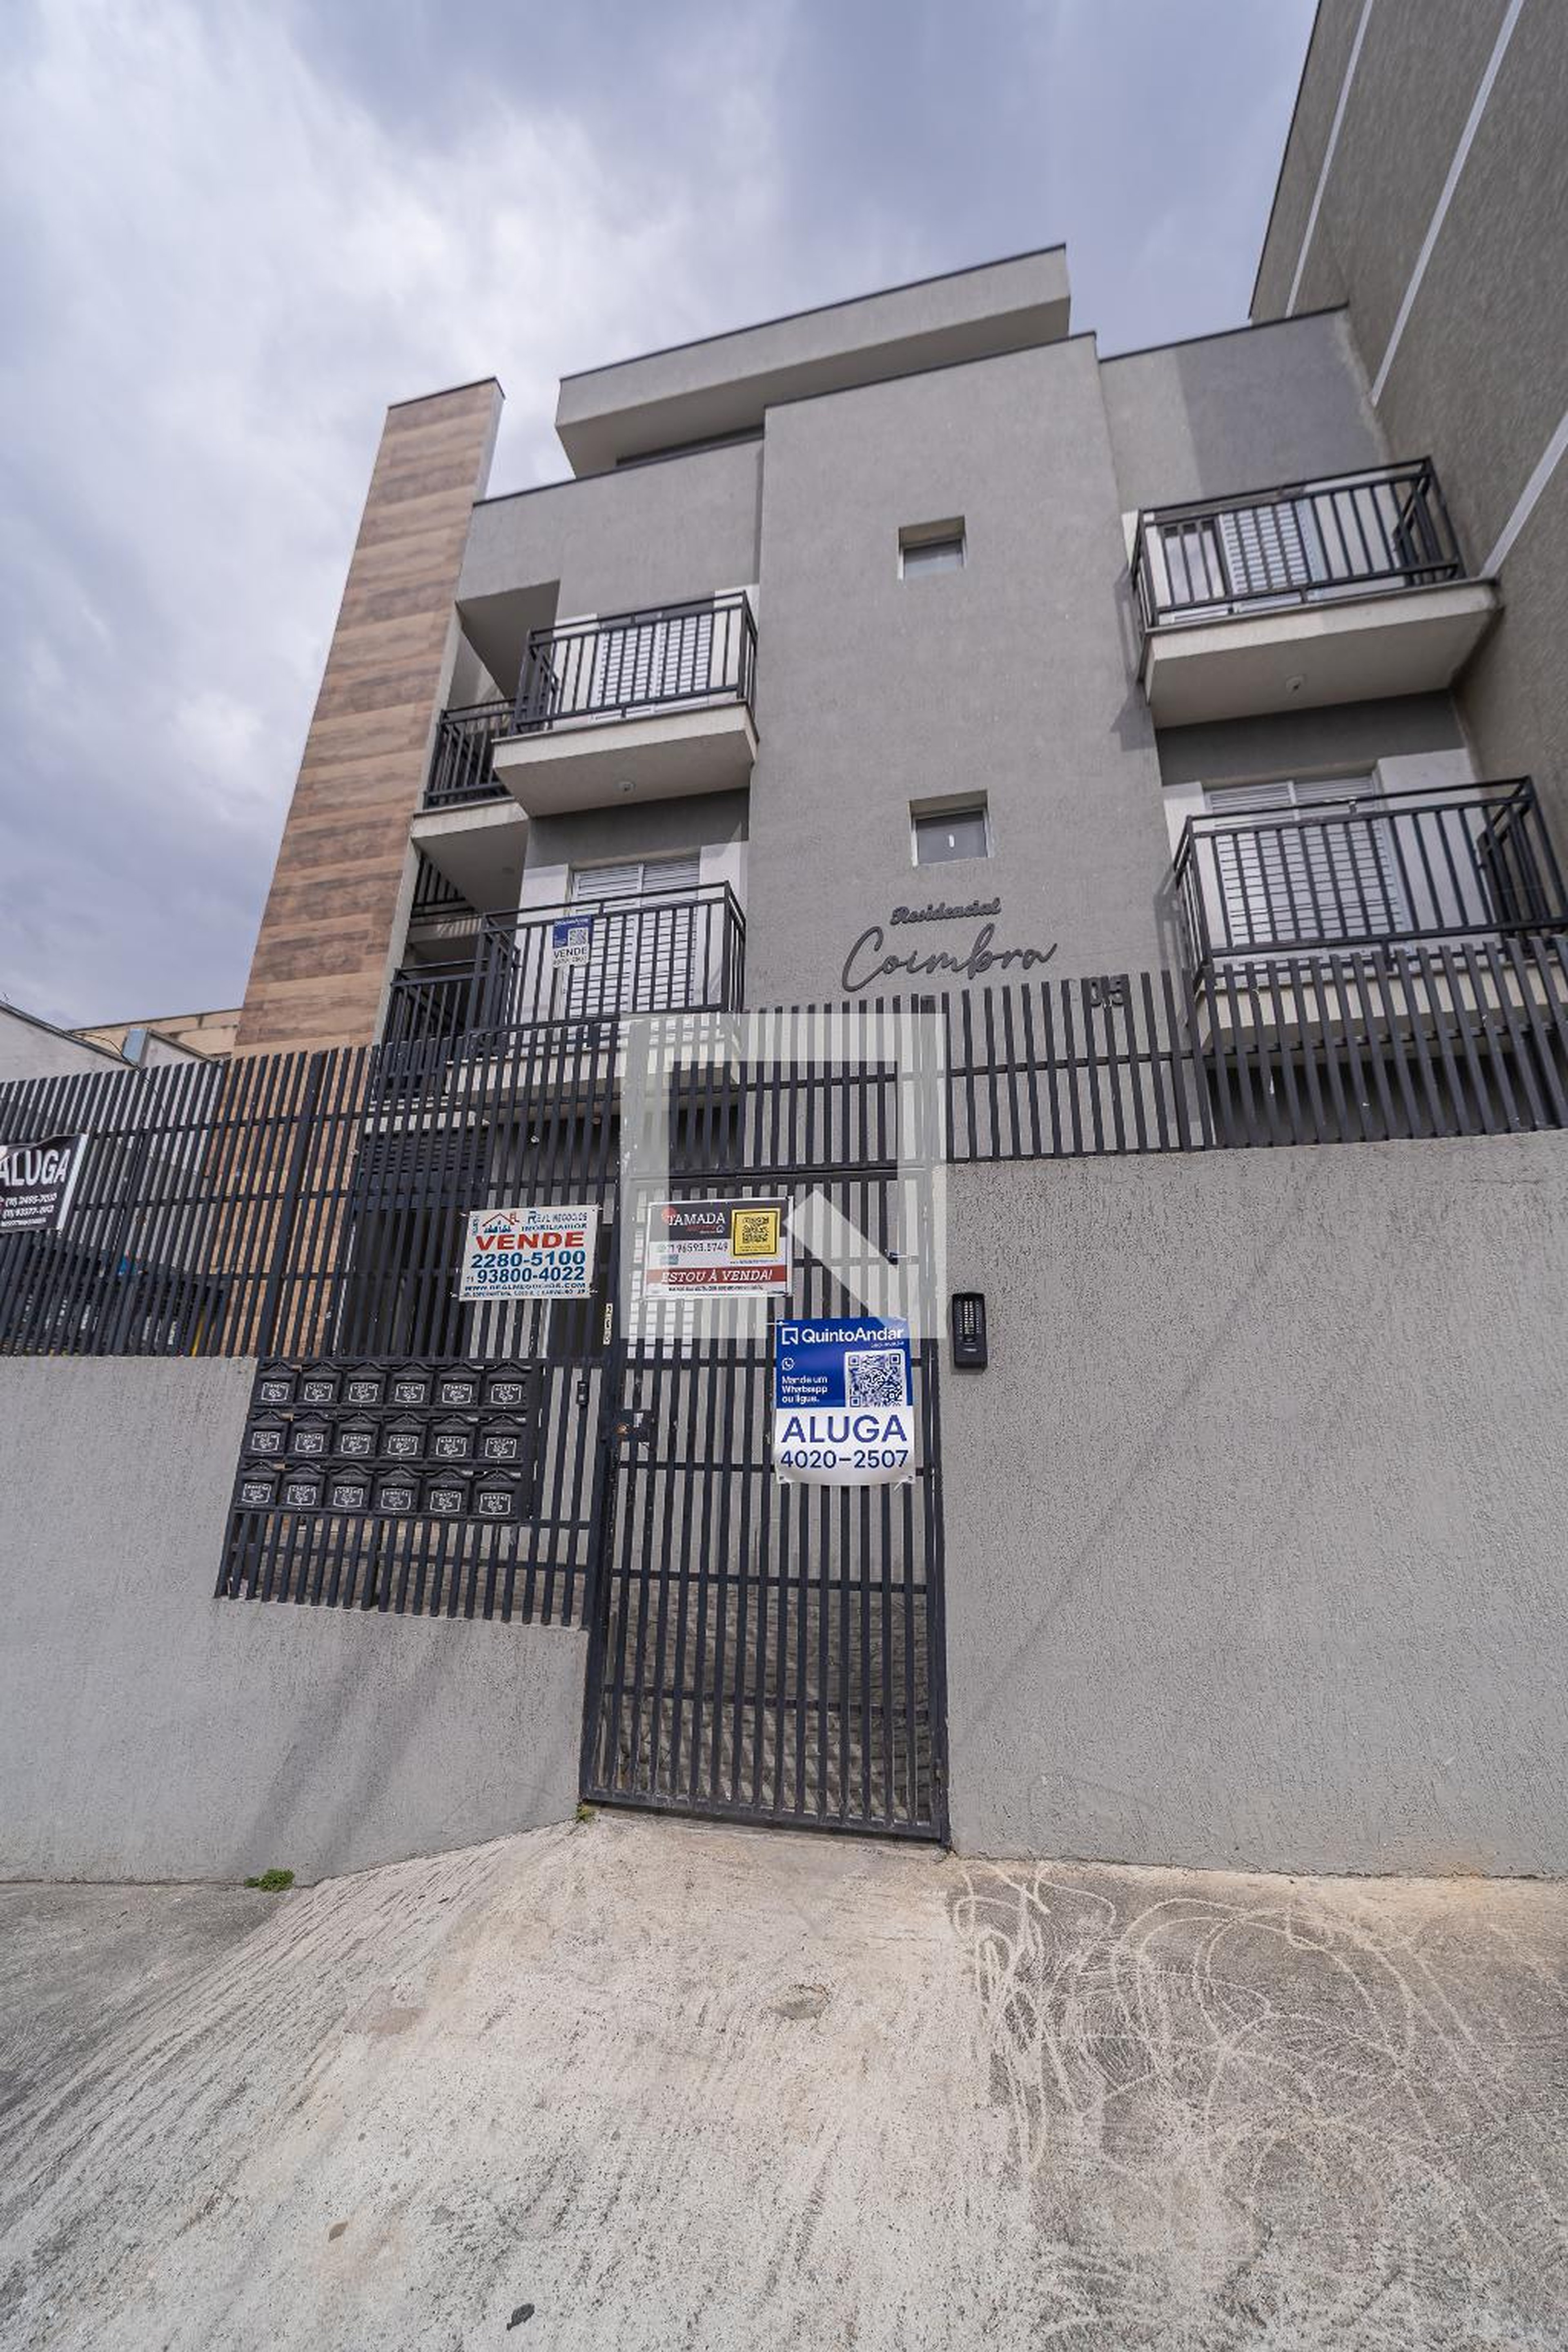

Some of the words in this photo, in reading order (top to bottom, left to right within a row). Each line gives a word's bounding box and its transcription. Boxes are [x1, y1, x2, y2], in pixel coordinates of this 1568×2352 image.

[554, 947, 587, 958] VENDE
[842, 923, 1058, 992] Coimbra
[0, 1149, 71, 1186] ALUGA
[667, 1212, 726, 1225] TAMADA
[476, 1231, 585, 1251] VENDE
[471, 1250, 586, 1268] 2280-5100
[477, 1266, 585, 1283] 93800-4022
[661, 1271, 707, 1283] ESTOU
[722, 1269, 773, 1281] VENDA!
[802, 1327, 904, 1343] QuintoAndar
[781, 1414, 907, 1443] ALUGA
[780, 1450, 909, 1469] 4020-2507
